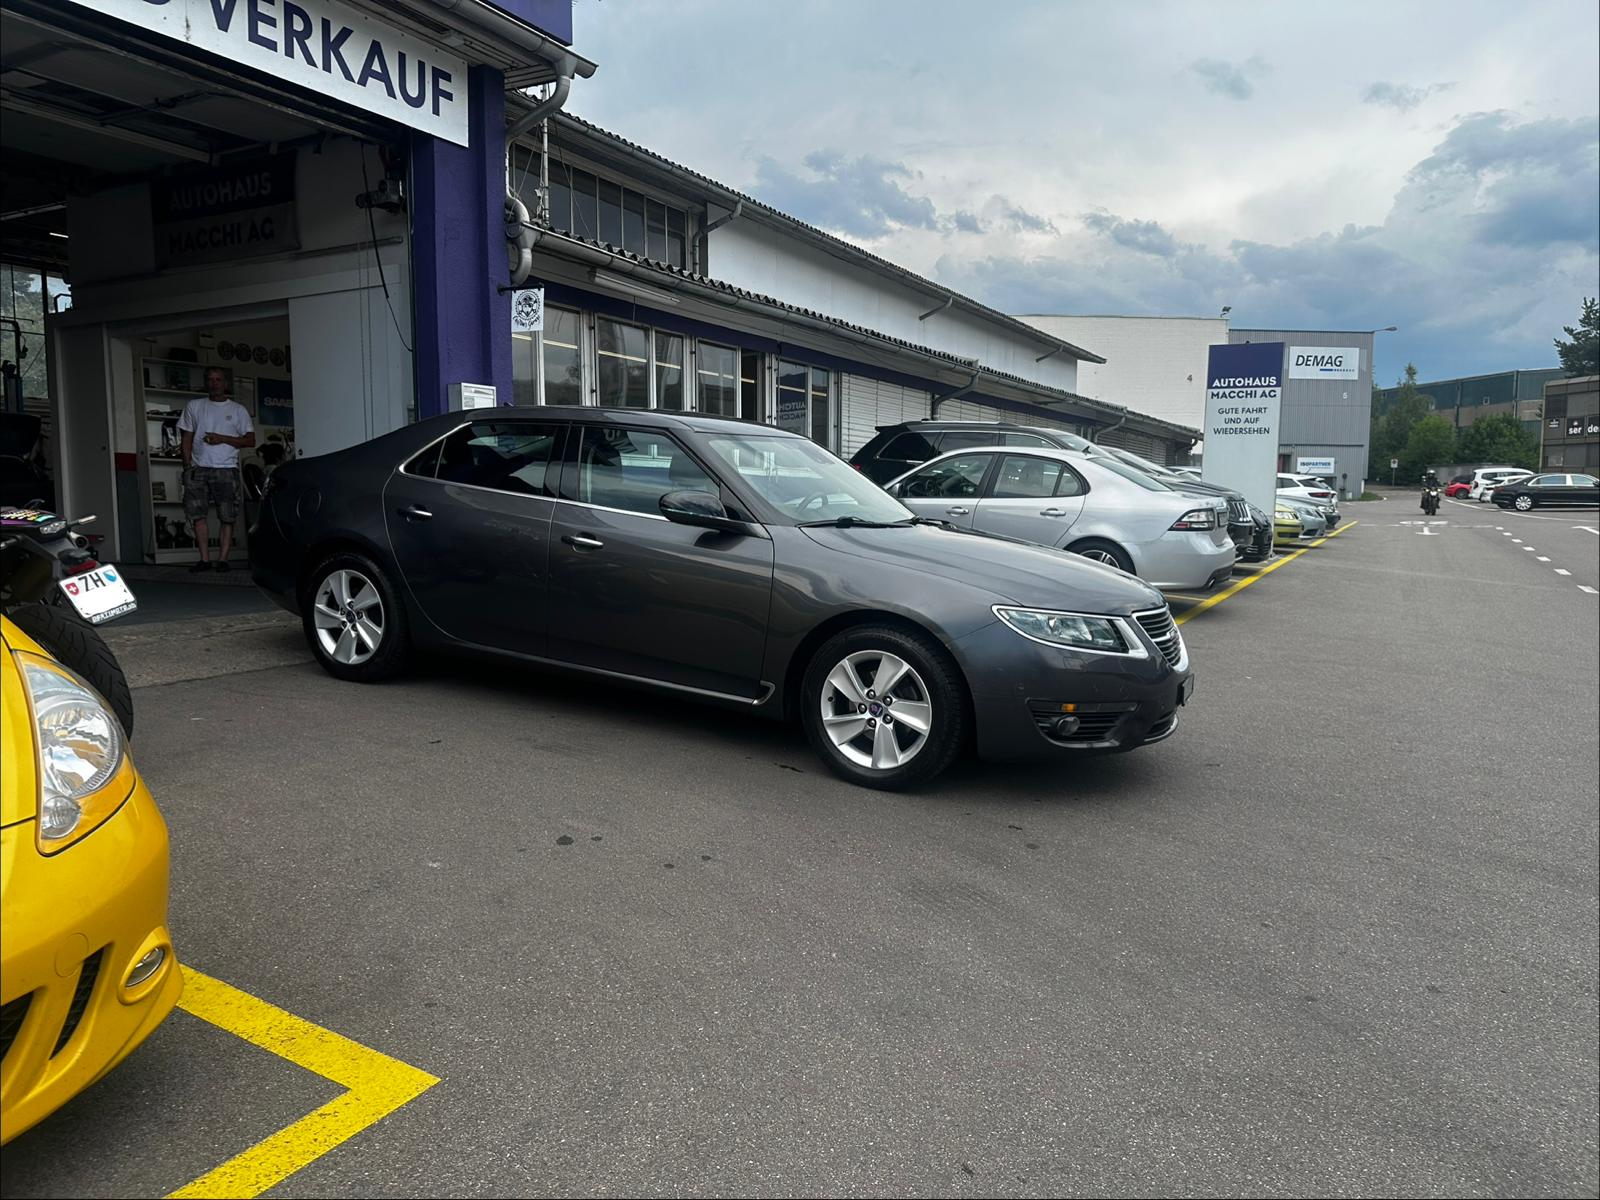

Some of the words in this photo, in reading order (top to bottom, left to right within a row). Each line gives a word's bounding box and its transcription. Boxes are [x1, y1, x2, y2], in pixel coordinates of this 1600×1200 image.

[210, 0, 454, 117] VERKAUF
[170, 172, 272, 210] AUTOHAUS
[168, 223, 241, 254] MACCHI
[247, 216, 274, 242] AG
[1295, 354, 1344, 367] DEMAG
[1212, 376, 1277, 388] AUTOHAUS
[1210, 390, 1257, 399] MACCHI
[1259, 389, 1277, 399] AG
[1217, 407, 1239, 415] GUTE
[1213, 427, 1270, 435] WIEDERSEHEN
[77, 571, 107, 592] ZH
